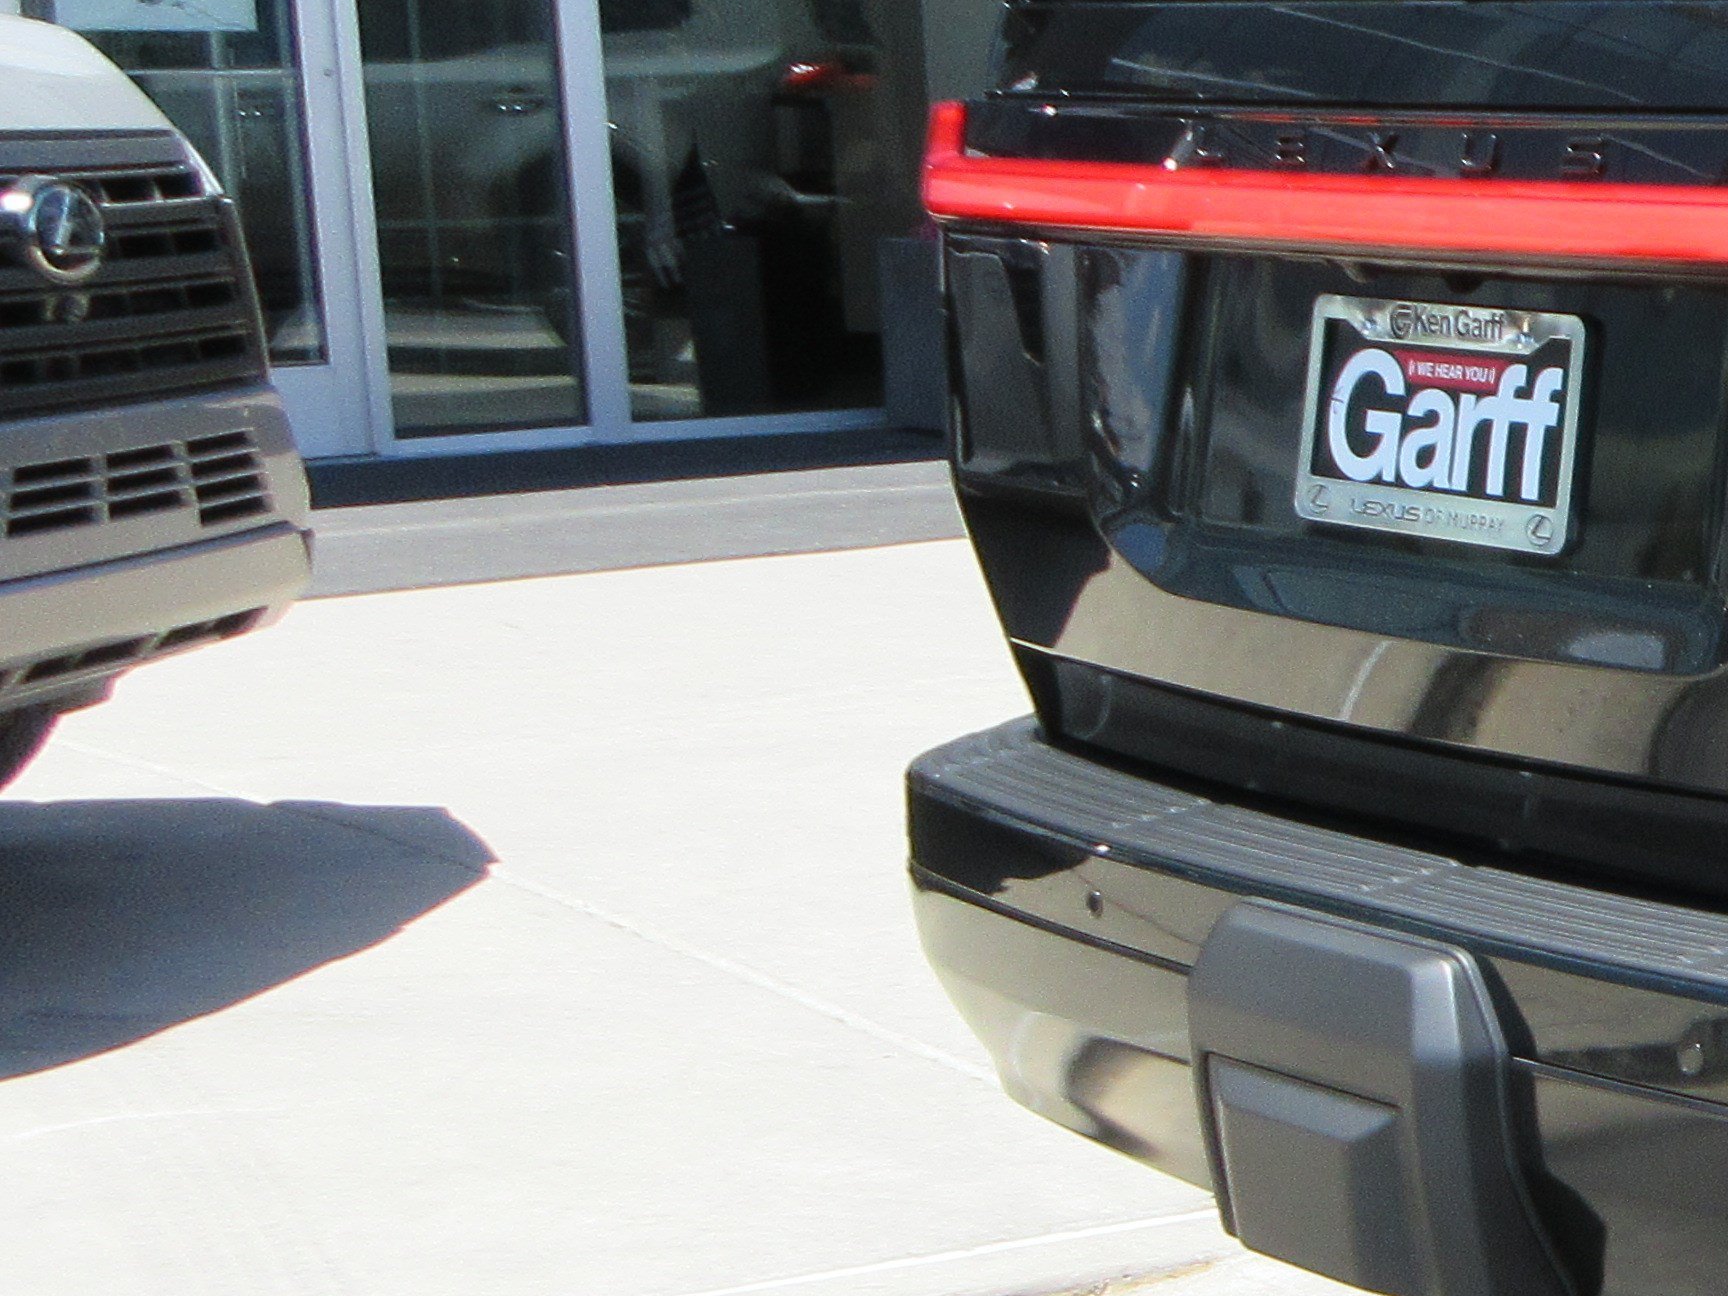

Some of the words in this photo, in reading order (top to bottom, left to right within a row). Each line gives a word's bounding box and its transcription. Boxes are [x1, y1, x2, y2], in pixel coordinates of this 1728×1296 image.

[1197, 125, 1605, 177] LEXUS
[1414, 304, 1451, 335] Ken
[1455, 309, 1505, 341] Garff
[1417, 361, 1434, 378] WE
[1434, 363, 1462, 380] HEAR
[1465, 366, 1489, 383] YOU
[1328, 348, 1563, 501] Garff
[1350, 497, 1421, 522] LEXUS
